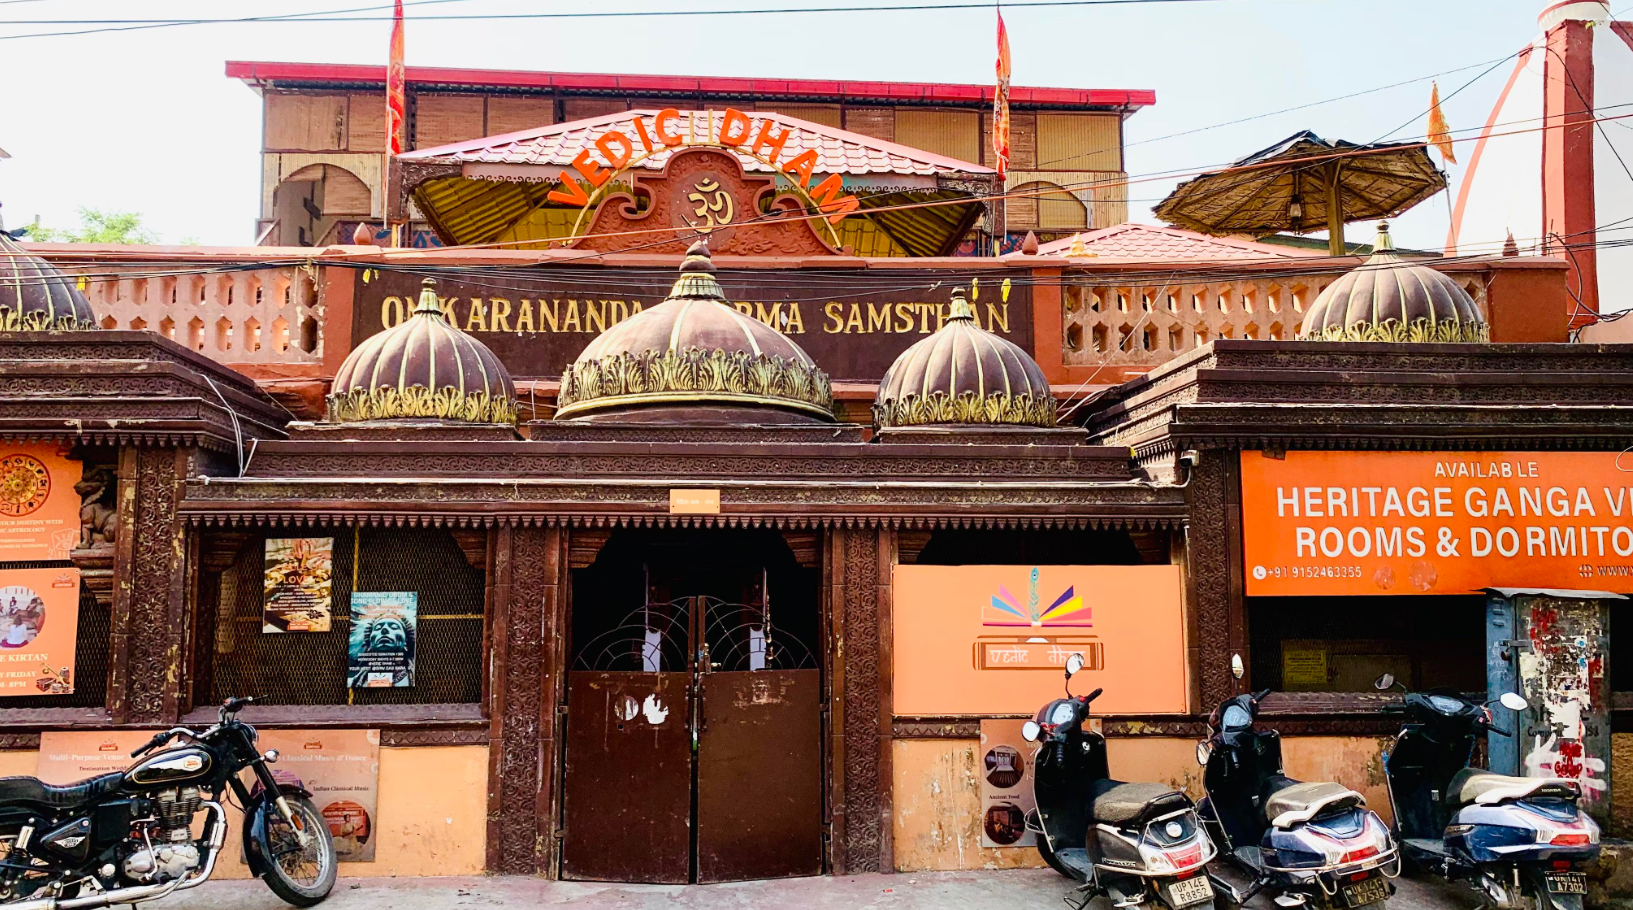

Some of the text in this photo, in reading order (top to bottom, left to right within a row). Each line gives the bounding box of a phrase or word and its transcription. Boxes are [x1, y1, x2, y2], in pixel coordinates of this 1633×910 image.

[546, 107, 860, 225] VEDIC DHAM
[1276, 486, 1454, 518] HERITAGE
[1464, 486, 1596, 518] GANGA
[1295, 526, 1633, 558] ROOMS & DORMITO
[1267, 565, 1362, 578] +91 9152463355
[8, 653, 48, 662] KIRTAN
[989, 644, 1086, 664] vedic dh
[102, 753, 126, 761] Venue
[282, 754, 313, 762] Classical
[1180, 887, 1209, 903] R8852
[1357, 888, 1385, 904] A7536
